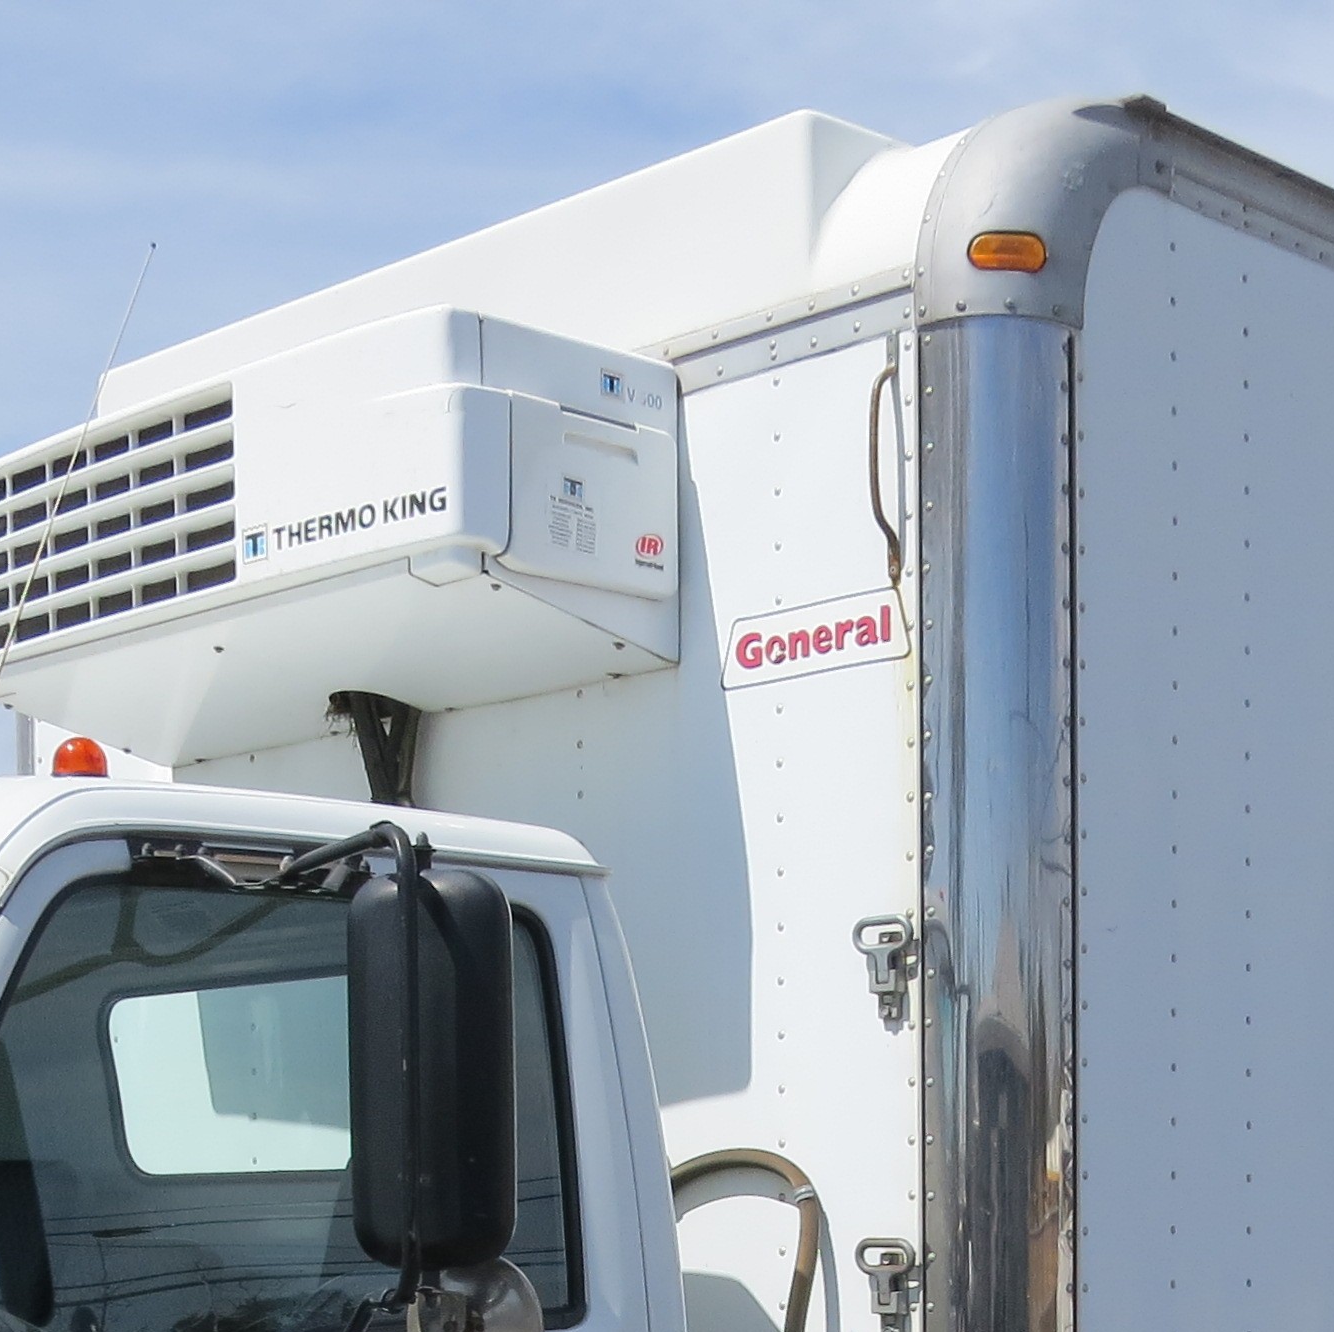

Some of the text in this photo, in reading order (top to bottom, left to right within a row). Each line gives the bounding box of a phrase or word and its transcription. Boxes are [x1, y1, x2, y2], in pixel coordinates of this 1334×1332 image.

[272, 503, 376, 550] THERMO
[382, 486, 447, 524] KING
[735, 604, 892, 670] General
